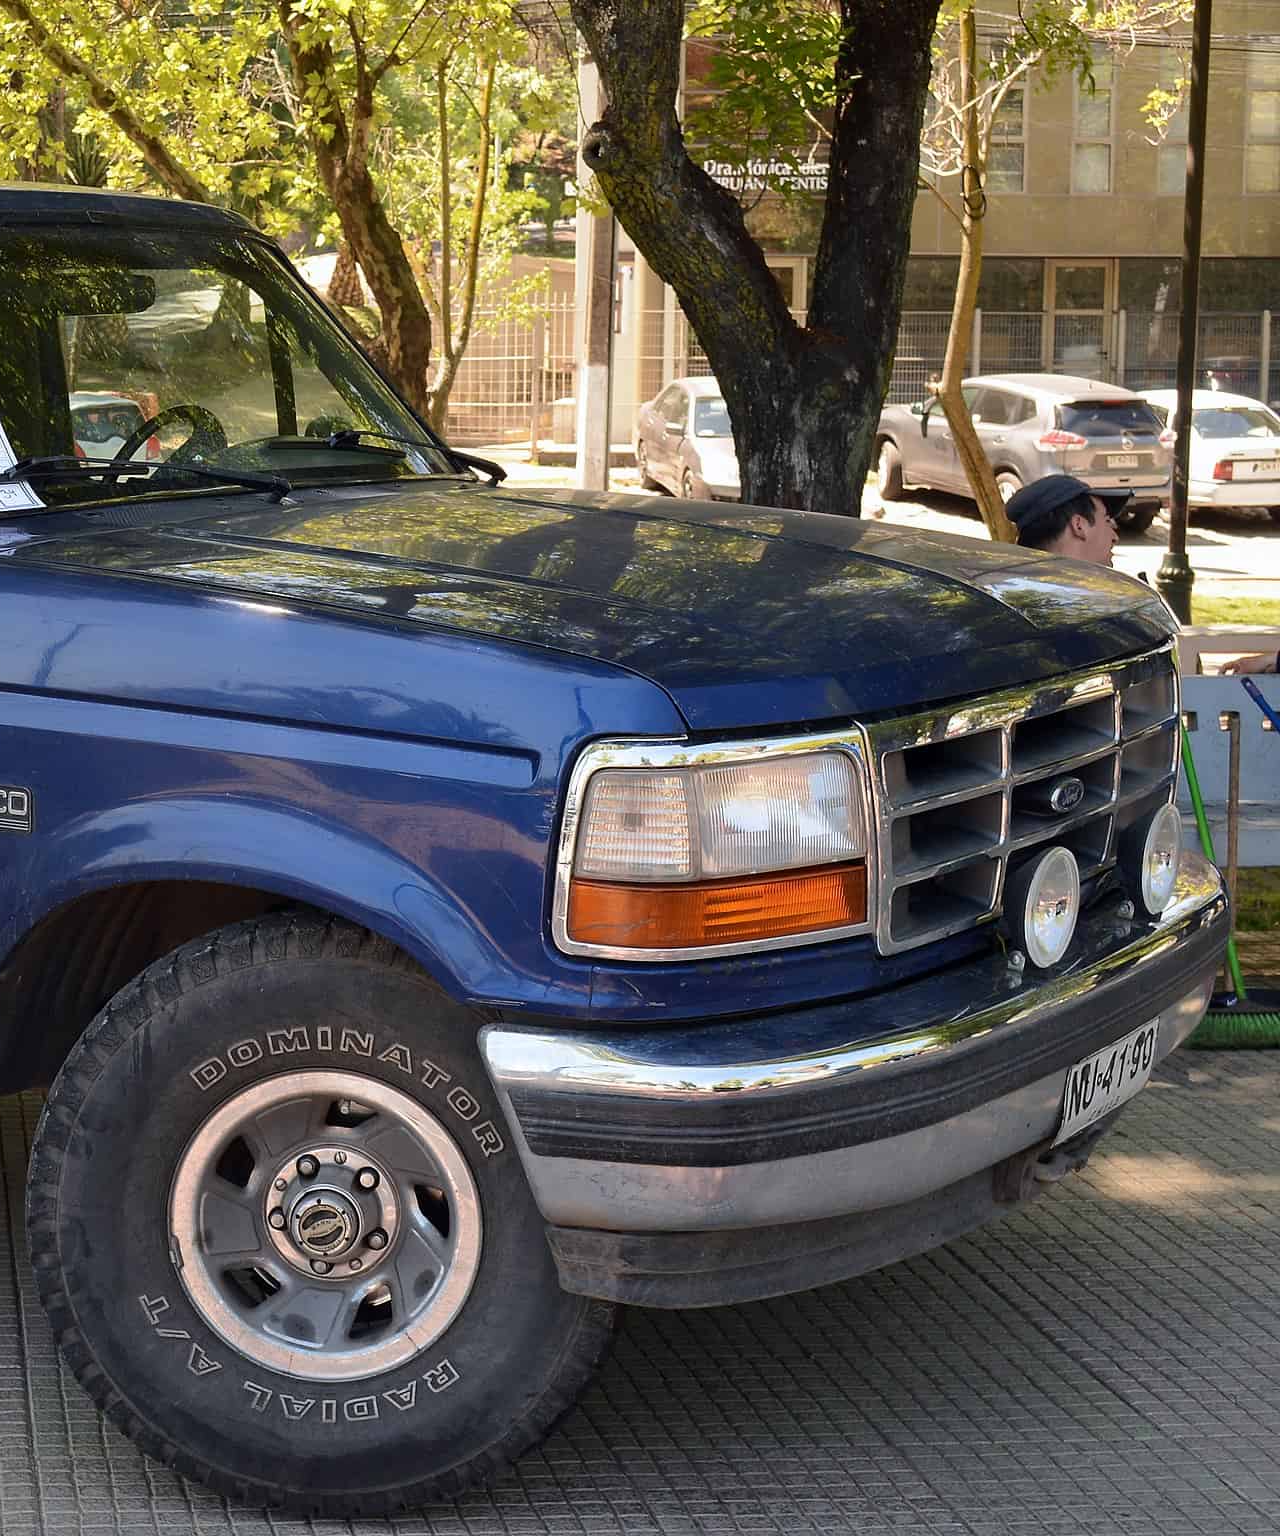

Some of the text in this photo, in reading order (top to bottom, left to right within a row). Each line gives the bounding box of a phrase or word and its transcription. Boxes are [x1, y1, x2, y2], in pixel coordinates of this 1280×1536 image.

[703, 159, 737, 176] Dra.
[711, 176, 773, 192] IRUJAN
[190, 1025, 506, 1157] DOMINATOR
[137, 1294, 462, 1424] RADIAL A/T
